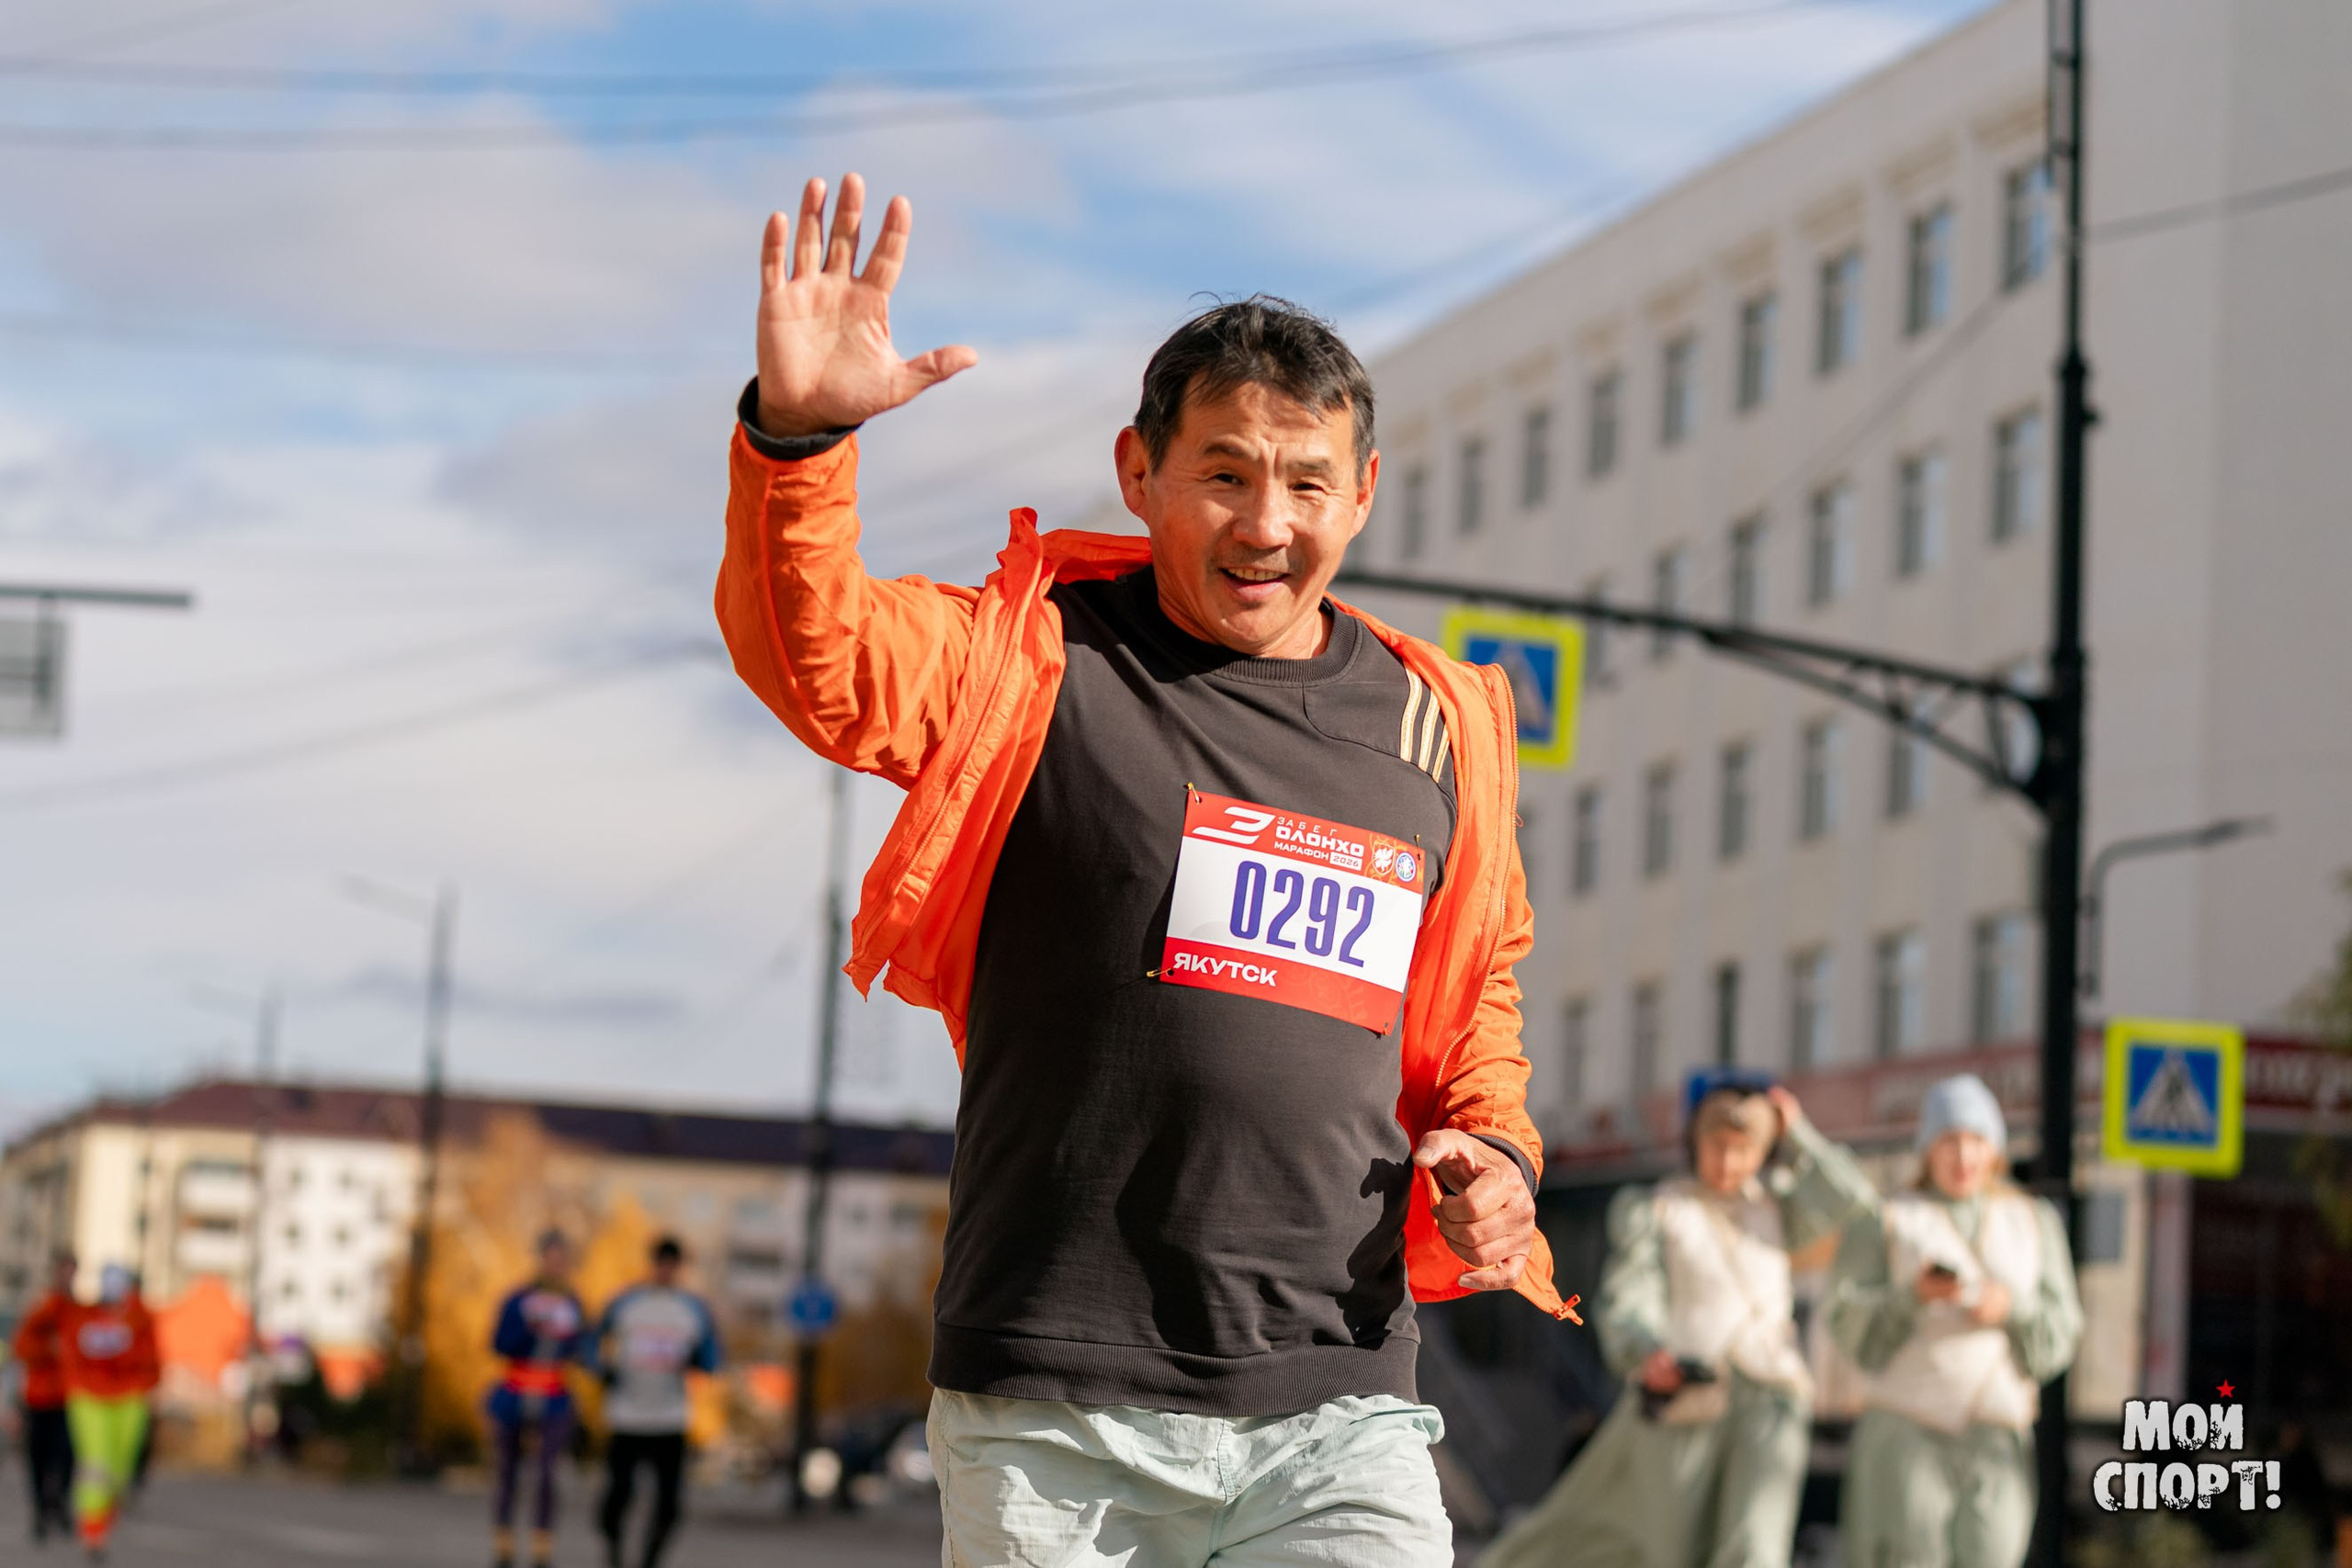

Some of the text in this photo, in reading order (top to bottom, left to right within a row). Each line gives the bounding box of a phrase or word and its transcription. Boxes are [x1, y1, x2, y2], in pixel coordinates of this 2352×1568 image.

[1275, 825, 1365, 858] ОЛОНХО
[1277, 816, 1338, 837] ЗАБЕГ
[1274, 840, 1360, 868] МАРАФОН 2026
[1229, 860, 1375, 968] 0292
[1172, 952, 1278, 987] ЯКУТСК
